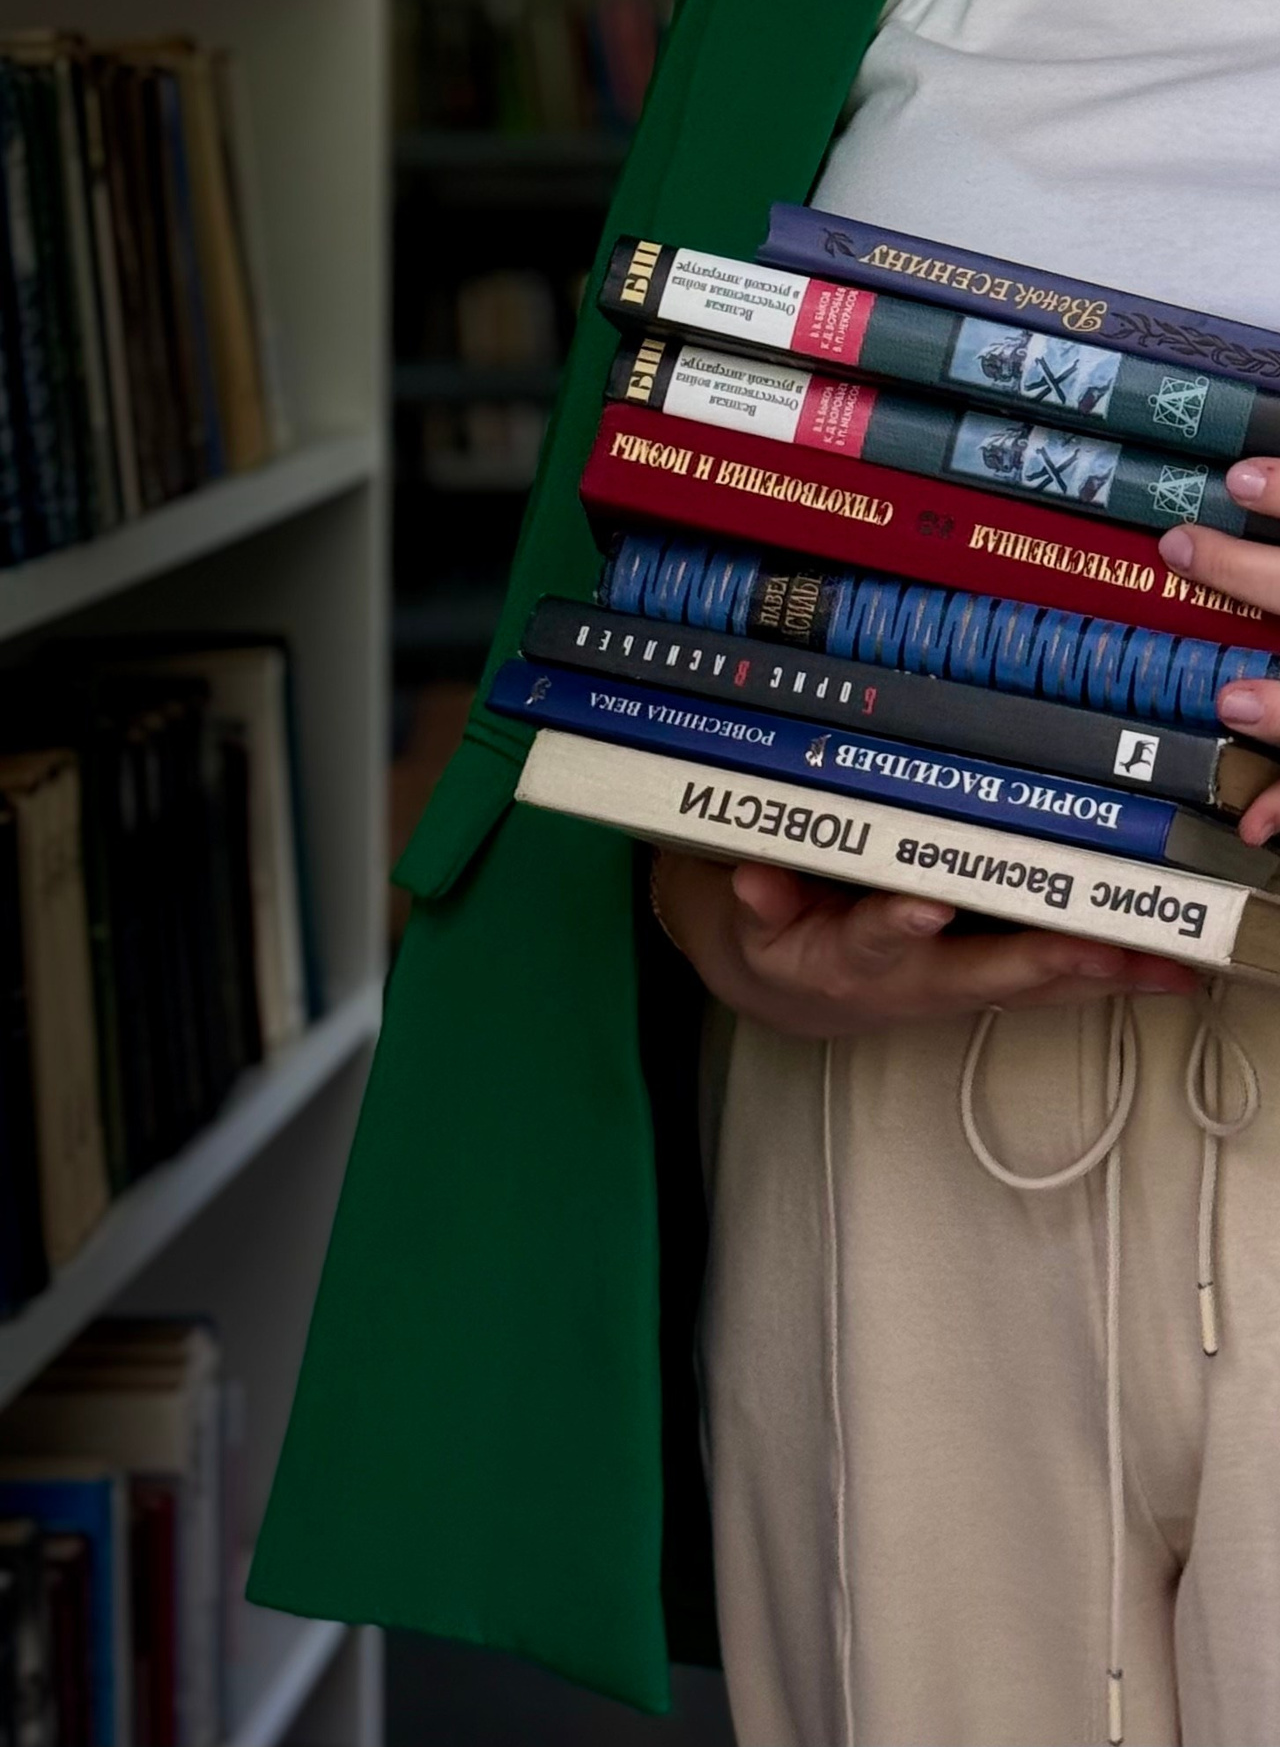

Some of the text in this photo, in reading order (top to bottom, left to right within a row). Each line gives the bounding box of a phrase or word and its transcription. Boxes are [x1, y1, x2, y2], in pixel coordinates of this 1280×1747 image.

[620, 240, 662, 307] БШ
[671, 275, 796, 316] Отечественная война
[676, 261, 743, 287] литературе
[743, 277, 790, 295] русской
[859, 244, 1107, 332] Венок ЕСЕНИНУ
[704, 298, 754, 321] Великая
[625, 337, 666, 405] БШ
[676, 372, 799, 411] Отечественная война
[681, 357, 747, 380] литературе
[748, 374, 795, 391] русской
[709, 395, 757, 417] Великая
[610, 432, 894, 526] СТИХОТВОРЕНИЯ И ПОЭМЫ
[968, 524, 1156, 592] ОТЕЧЕСТВЕННАЯ
[759, 576, 790, 627] ПАВЕЛ
[575, 625, 877, 715] БОРИС ВАСИЛЬЕВ
[589, 691, 776, 747] РОВЕСНИЦА ВЕКА
[834, 743, 1123, 829] БОРИС ВАСИЛЬЕВ
[679, 782, 1208, 939] Борис Васильев ПОВЕСТИ
